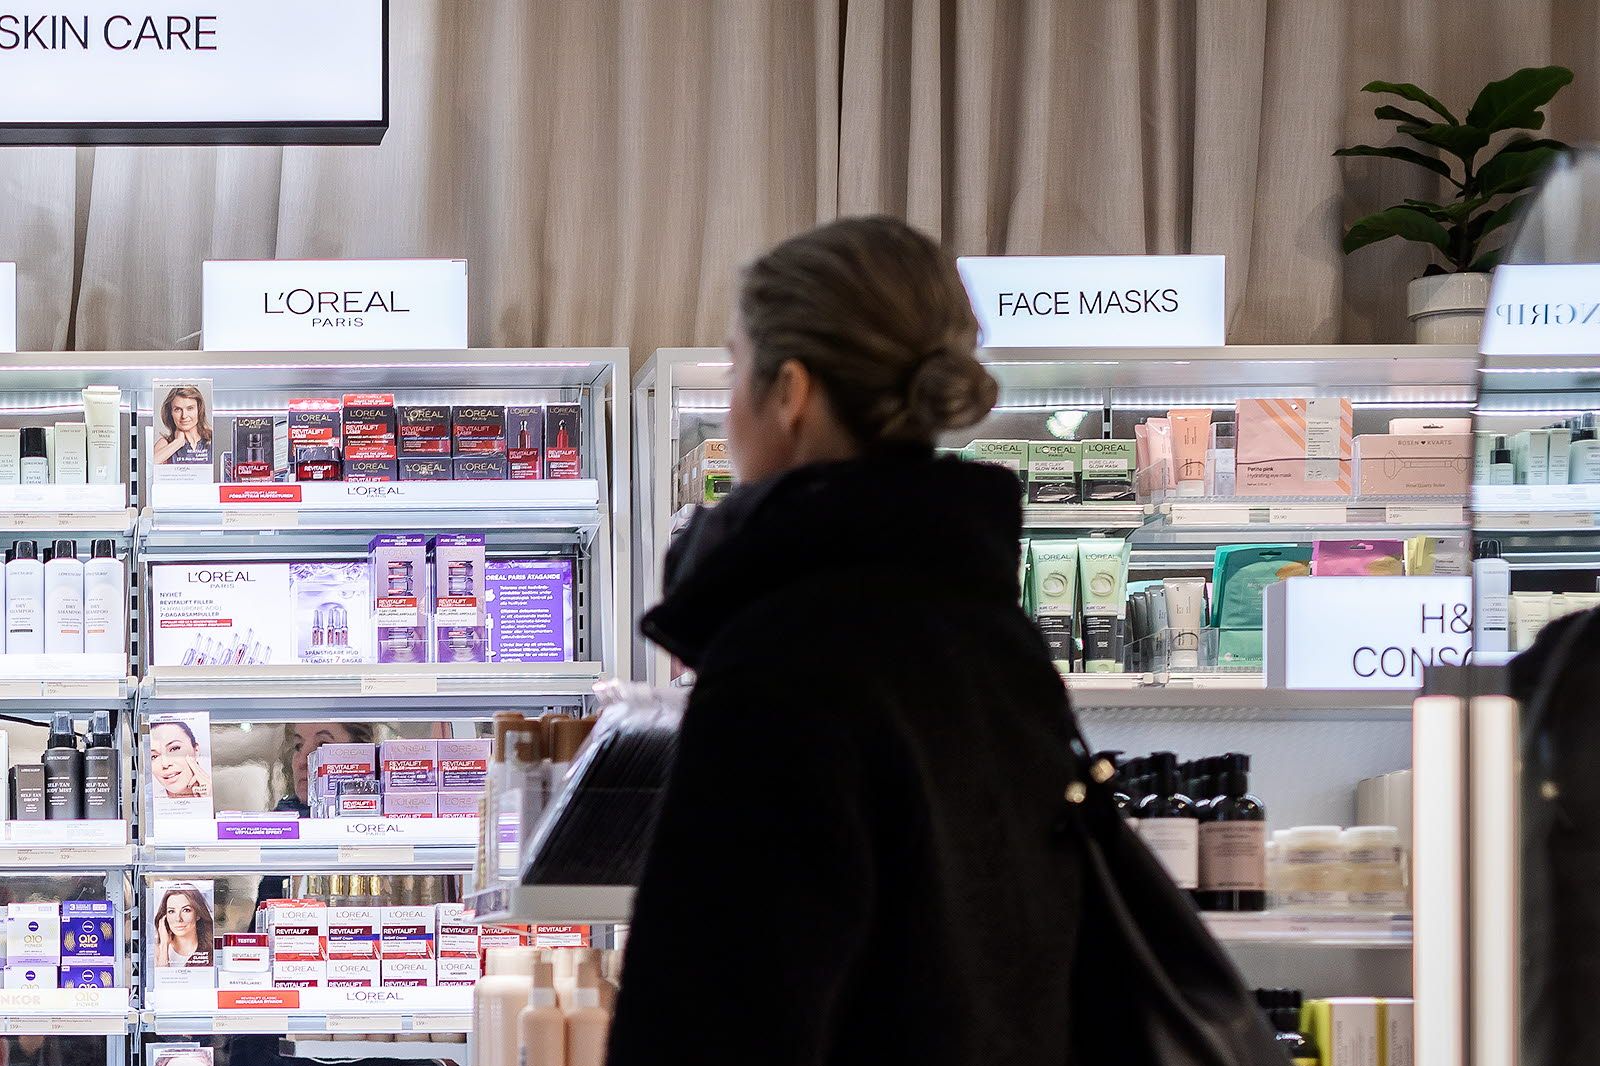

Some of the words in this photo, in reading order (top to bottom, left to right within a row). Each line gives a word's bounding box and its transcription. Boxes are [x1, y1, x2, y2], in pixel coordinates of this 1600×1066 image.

[102, 14, 218, 50] CARE
[264, 288, 411, 314] L'OREAL
[998, 291, 1069, 316] FACE
[1079, 289, 1179, 315] MASKS
[1089, 443, 1129, 452] L'ORÉAL
[347, 485, 405, 495] L'ORÉAL
[188, 570, 256, 583] L'ORÉAL
[347, 824, 404, 832] L'ORÉAL
[78, 934, 99, 944] Q10
[346, 991, 404, 1001] L'ORÉAL
